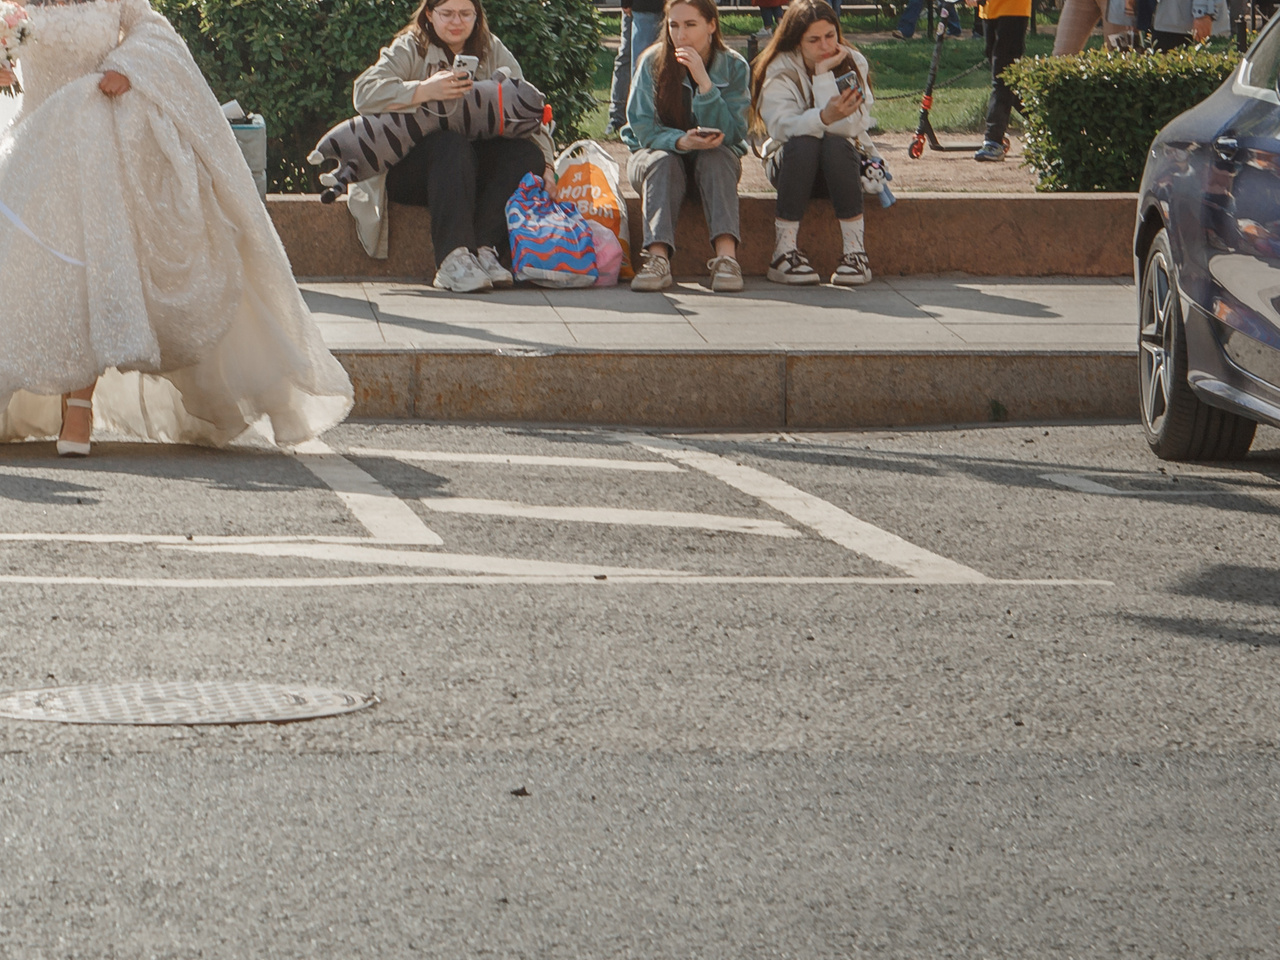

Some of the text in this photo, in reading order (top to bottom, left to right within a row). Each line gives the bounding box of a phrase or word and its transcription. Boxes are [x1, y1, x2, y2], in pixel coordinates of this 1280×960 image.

[572, 172, 582, 183] Я
[559, 184, 608, 199] НОГО-
[577, 200, 614, 219] ВЫЙ
